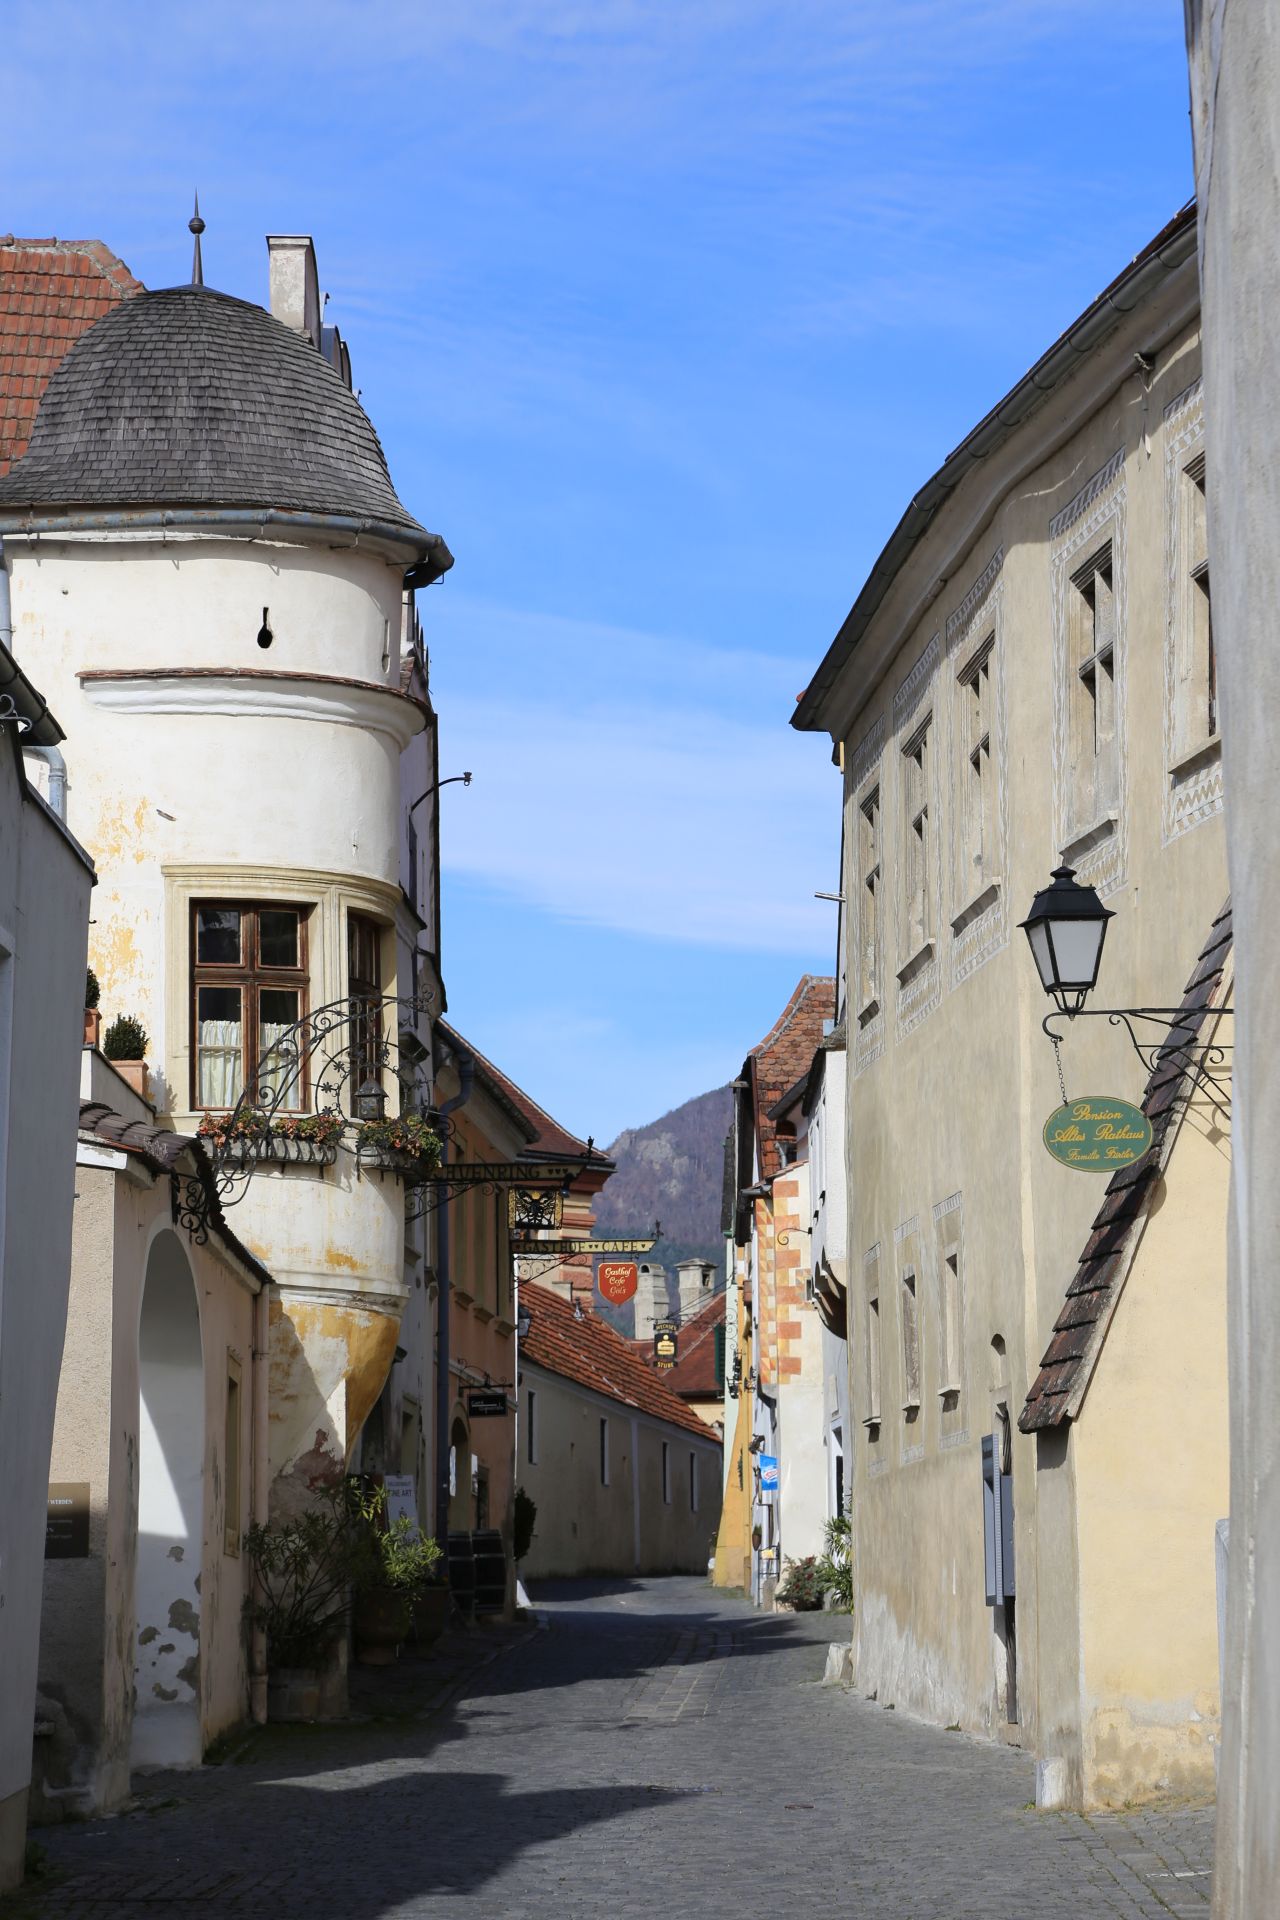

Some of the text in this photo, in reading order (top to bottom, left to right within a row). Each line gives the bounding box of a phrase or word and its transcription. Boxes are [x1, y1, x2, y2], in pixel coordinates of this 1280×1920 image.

[1071, 1104, 1123, 1120] Pension
[1050, 1123, 1144, 1142] Altes Rathaus
[1066, 1148, 1100, 1160] Familie
[523, 1241, 638, 1252] GASTHOF CAFE
[605, 1267, 633, 1278] Gasthof
